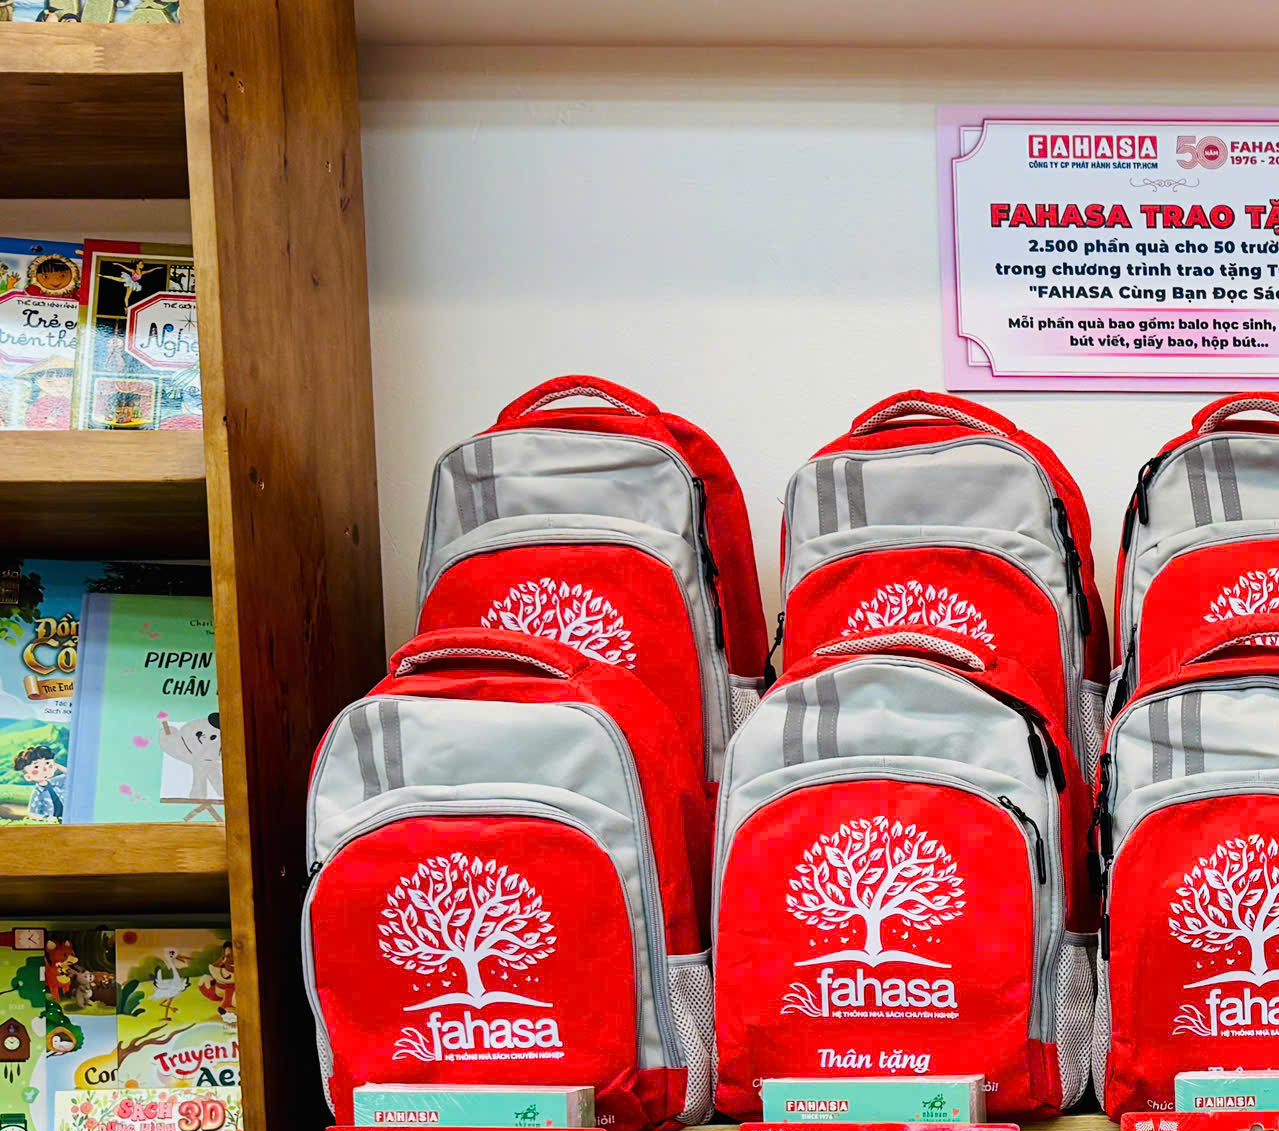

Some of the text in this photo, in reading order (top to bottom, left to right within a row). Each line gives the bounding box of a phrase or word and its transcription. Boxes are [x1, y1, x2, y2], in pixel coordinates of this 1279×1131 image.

[1029, 135, 1157, 158] FAHASA
[1176, 136, 1228, 169] 50
[1029, 160, 1048, 169] CÔNG
[1072, 160, 1089, 169] PHÁT
[1091, 160, 1110, 169] HÀNH
[1112, 160, 1131, 169] SÁCH
[1230, 156, 1257, 165] 1976
[990, 203, 1132, 229] FAHASA
[1140, 204, 1235, 229] TRAO
[1028, 239, 1078, 253] 2.500
[1084, 238, 1130, 257] phần
[1135, 240, 1169, 257] quà
[1175, 241, 1209, 254] cho
[1214, 241, 1235, 254] 50
[995, 263, 1046, 279] trong
[1052, 262, 1121, 279] chương
[1127, 263, 1171, 278] trình
[1177, 264, 1214, 278] trao
[1220, 263, 1262, 280] tặng
[1029, 286, 1113, 300] "FAHASA
[1119, 286, 1166, 302] Cùng
[1172, 287, 1207, 303] Bạn
[1213, 287, 1248, 304] Đọc
[22, 309, 77, 329] Trẻ e
[1008, 315, 1034, 329] Mỗi
[1038, 316, 1074, 332] phần
[1078, 318, 1105, 332] quà
[1109, 318, 1135, 330] bao
[1139, 317, 1175, 332] gồm:
[1179, 319, 1209, 330] balo
[1213, 319, 1239, 333] học
[1243, 319, 1276, 332] sinh,
[1070, 335, 1269, 351] bút viết, giấy bao, hộp bút...
[144, 651, 213, 669] PIPPIN
[817, 968, 958, 1017] fahasa
[427, 1011, 563, 1062] fahasa
[154, 1044, 228, 1075] Truyện
[817, 1048, 931, 1074] Thân tặng
[197, 1067, 241, 1087] Ae
[786, 1101, 848, 1112] FAHASA
[1147, 1100, 1174, 1111] Chúc
[1195, 1096, 1256, 1107] FAHASA
[375, 1111, 439, 1122] FAHASA
